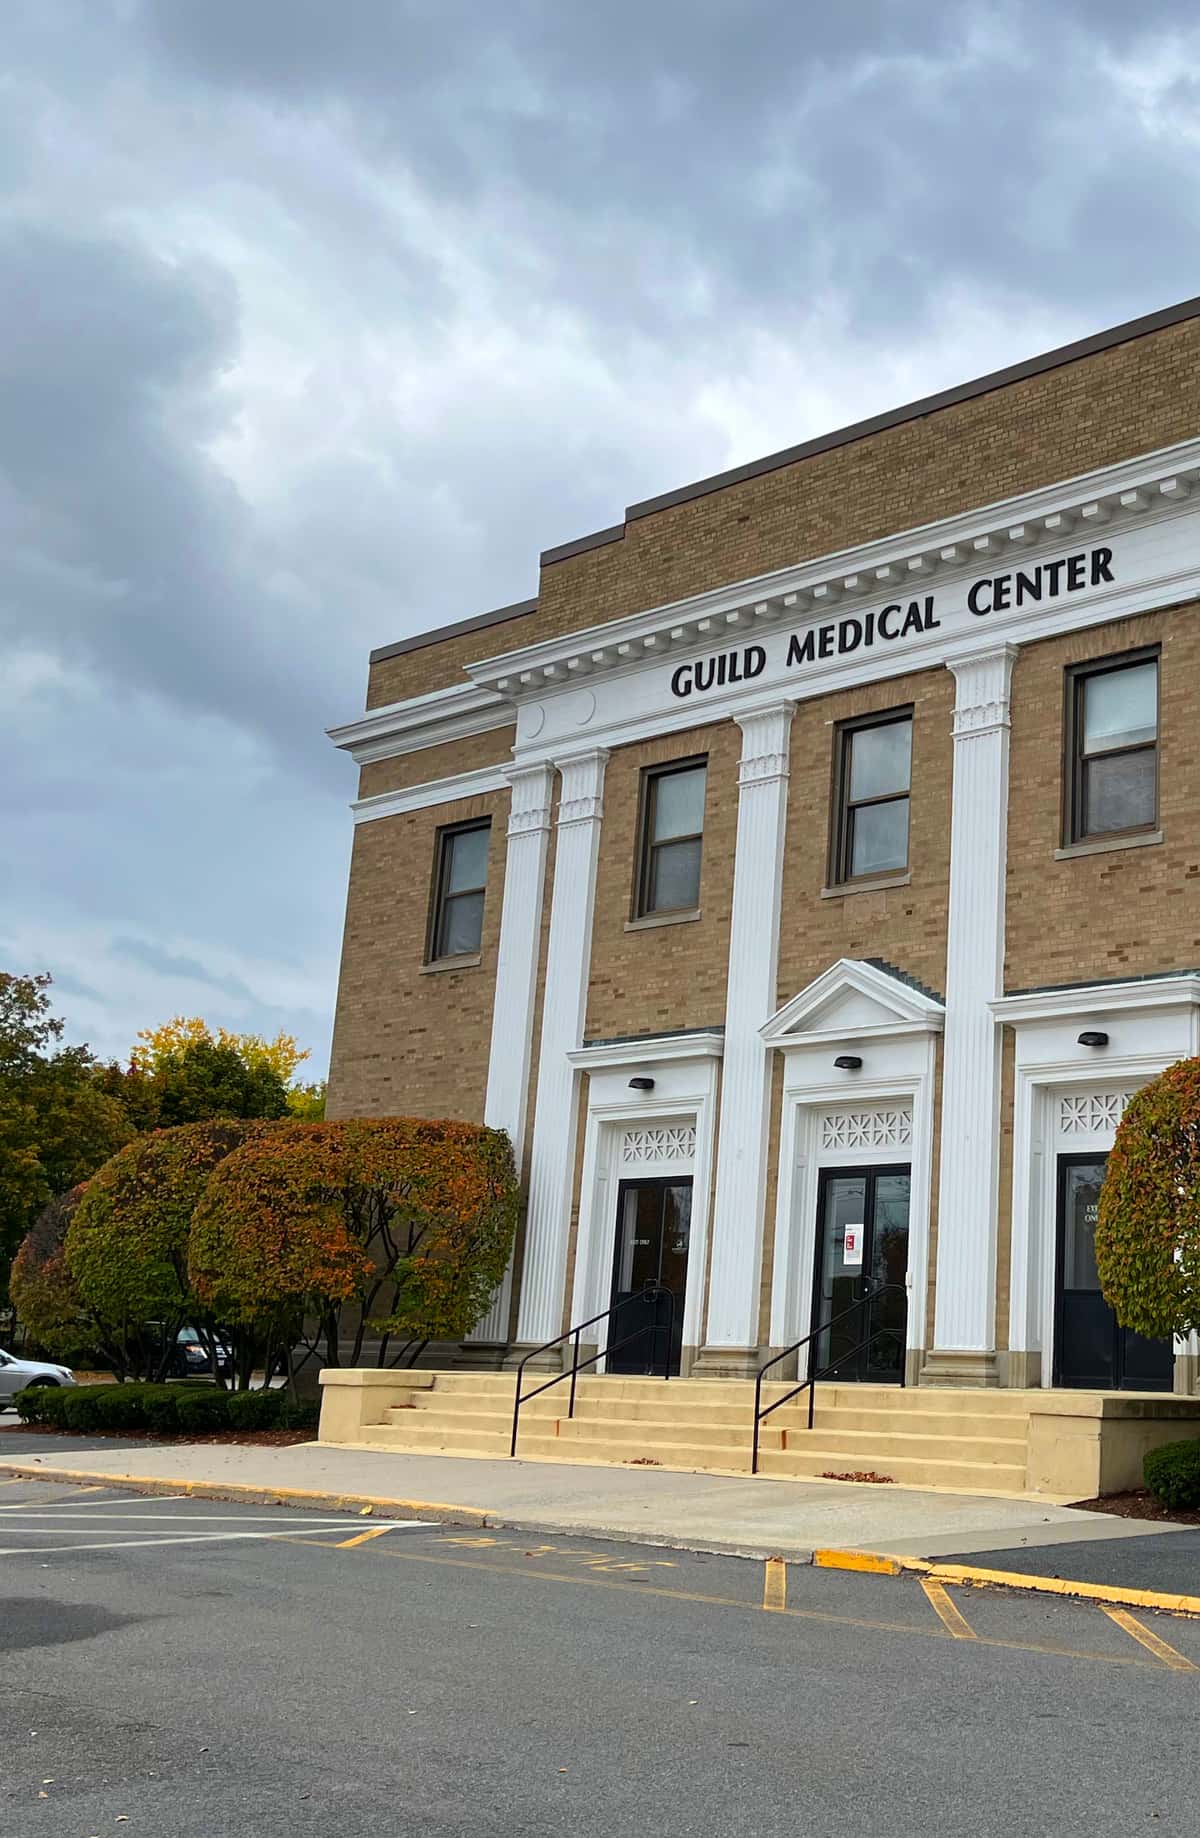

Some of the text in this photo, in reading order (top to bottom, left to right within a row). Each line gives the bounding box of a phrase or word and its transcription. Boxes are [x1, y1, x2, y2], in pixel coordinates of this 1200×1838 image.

[671, 547, 1115, 697] GUILD MEDICAL CENTER
